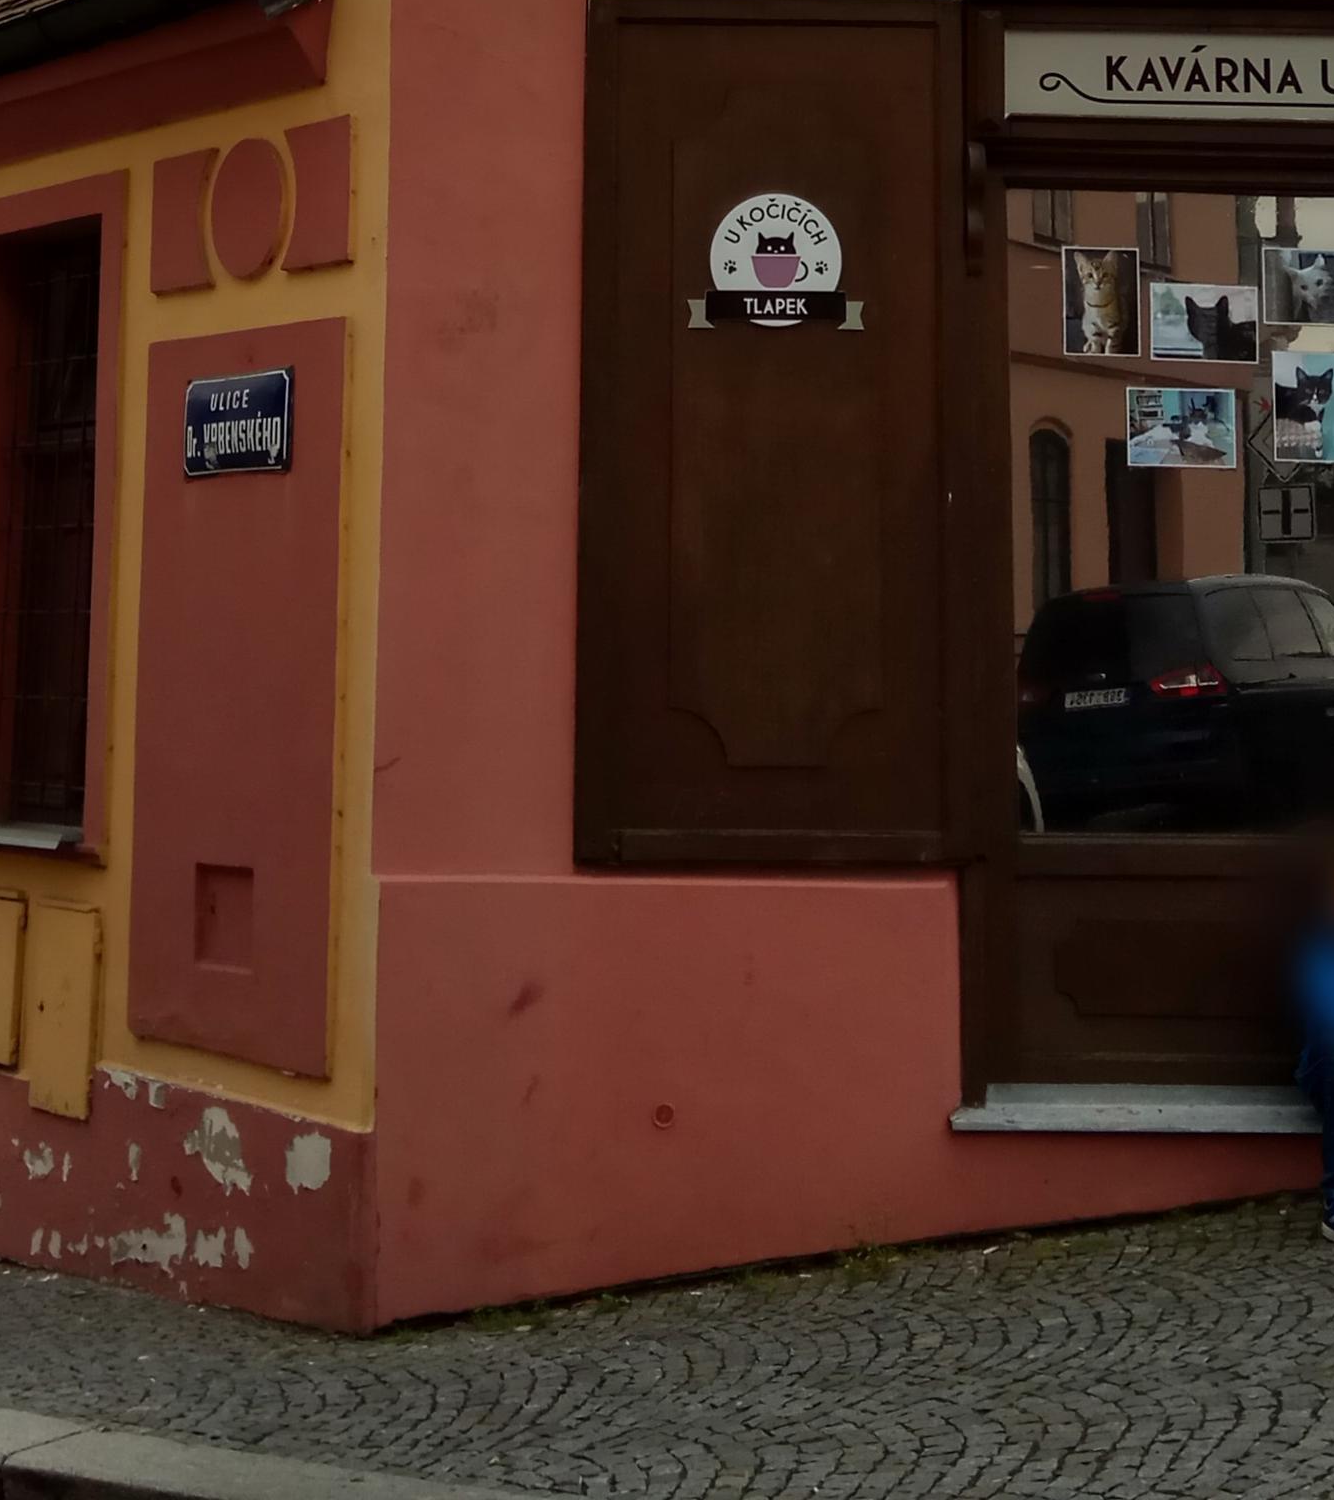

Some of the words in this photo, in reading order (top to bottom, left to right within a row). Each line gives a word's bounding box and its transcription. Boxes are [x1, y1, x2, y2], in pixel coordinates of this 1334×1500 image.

[1106, 45, 1303, 93] KAVÁRNA
[724, 229, 741, 244] U
[736, 198, 827, 245] KOČIČÍCH
[743, 298, 808, 315] TLAPEK
[210, 389, 249, 411] ULICE
[186, 426, 201, 457] Dr.
